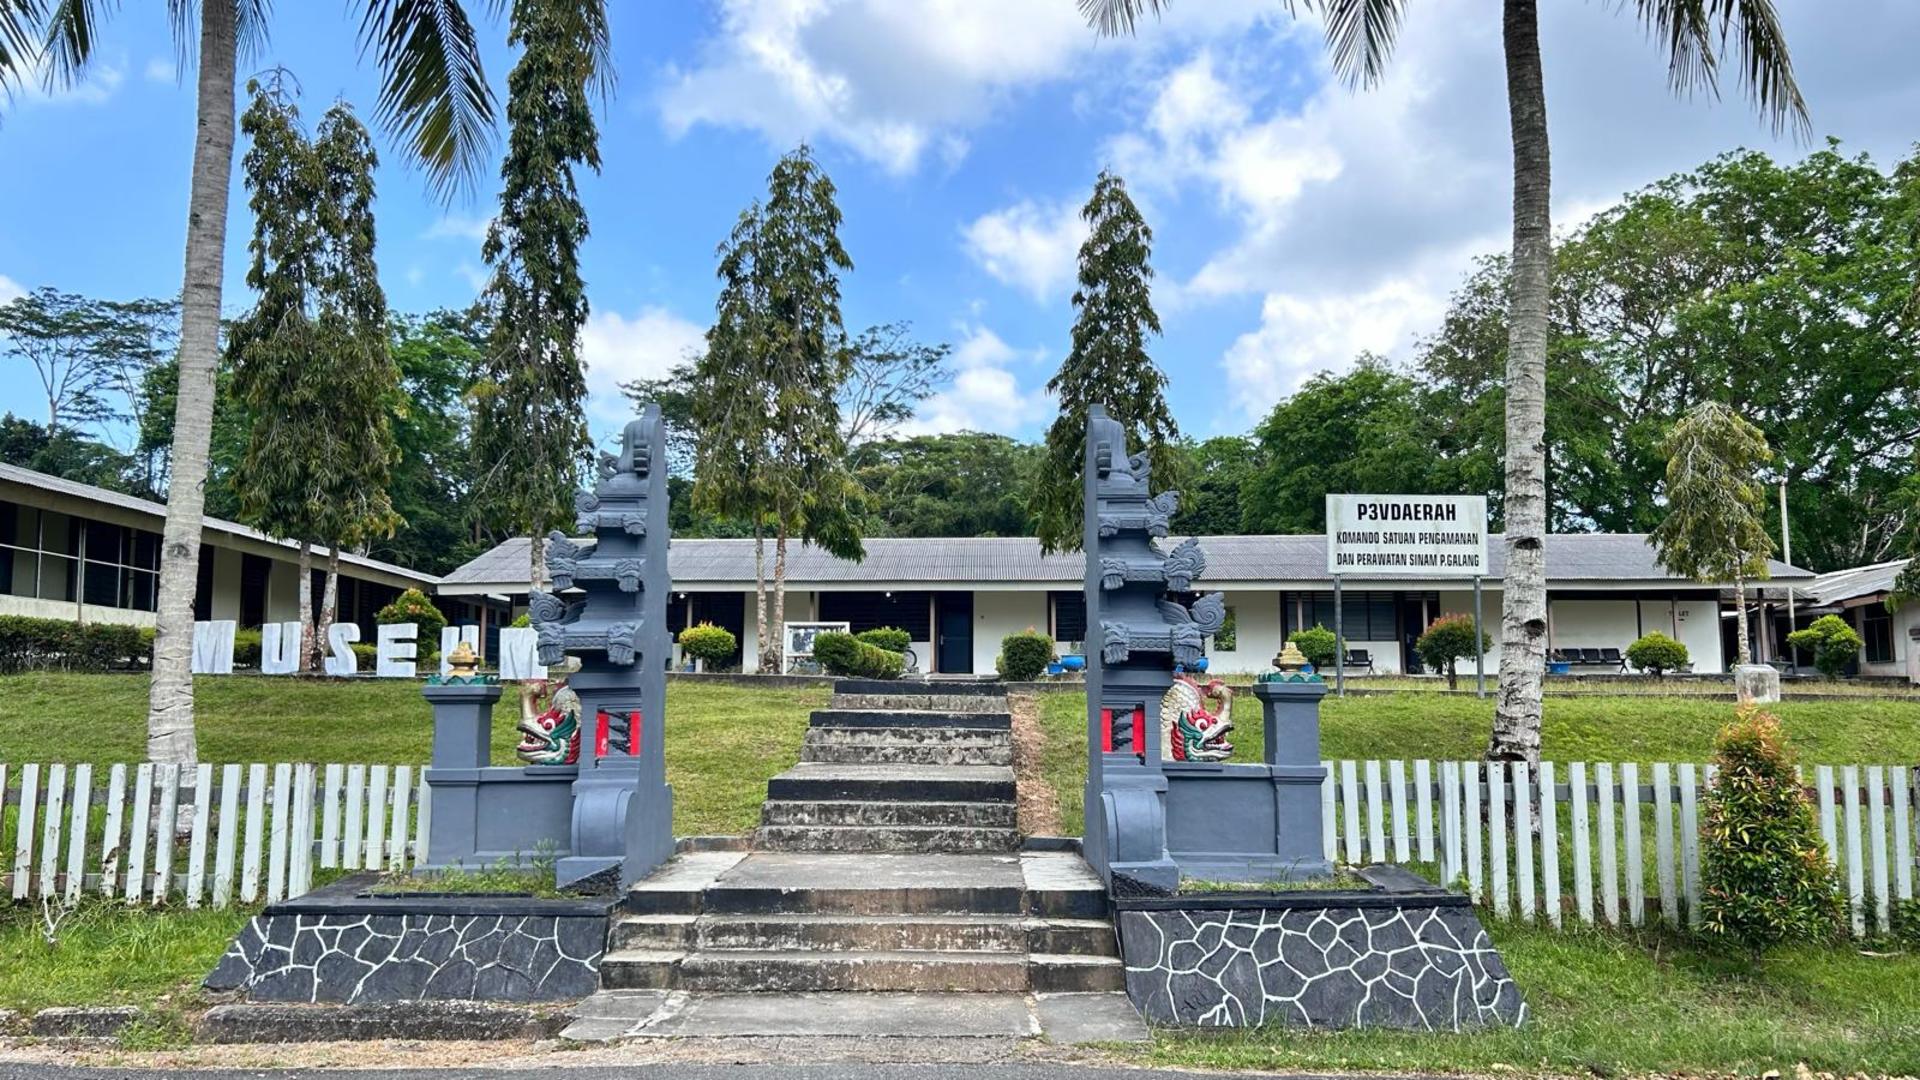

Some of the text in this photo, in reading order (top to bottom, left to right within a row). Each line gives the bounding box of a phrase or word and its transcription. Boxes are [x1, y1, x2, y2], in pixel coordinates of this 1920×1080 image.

[1336, 531, 1479, 545] KOMANDO SATUAN PENGAMANAN
[1336, 552, 1480, 567] DAN PERAWATAN SINAM P.GALANG
